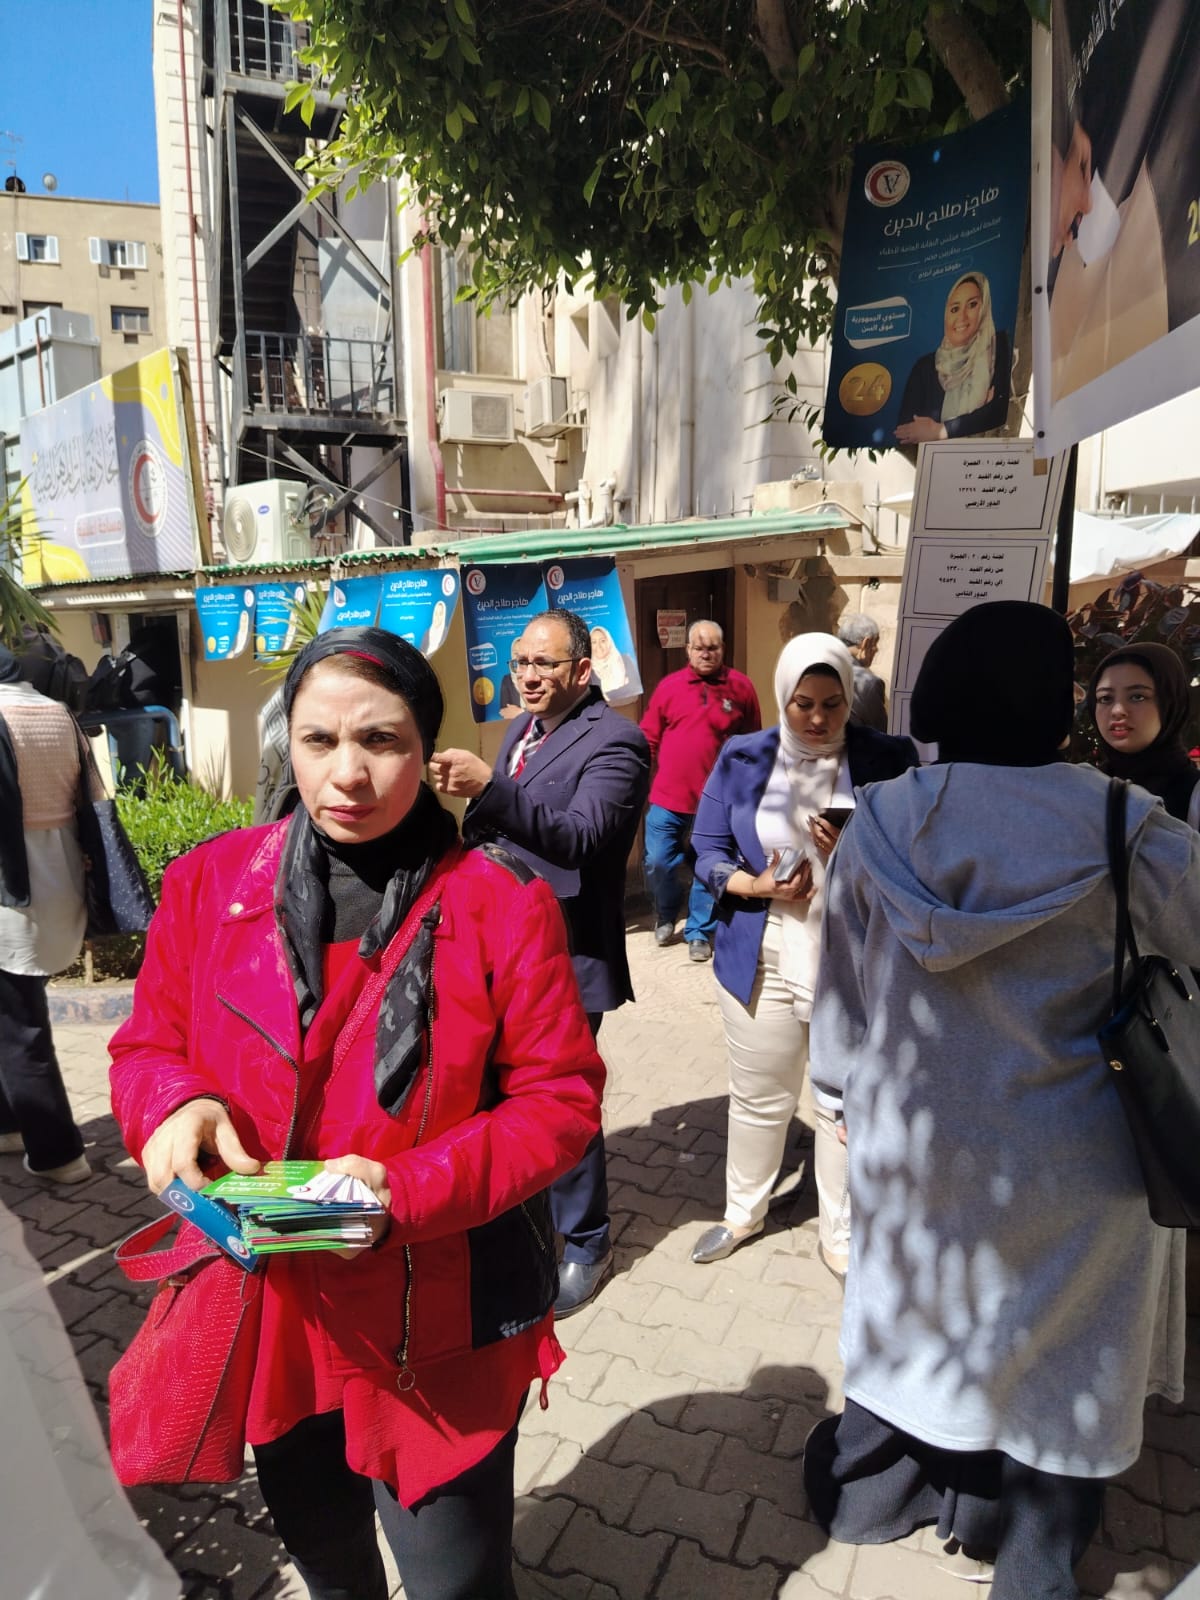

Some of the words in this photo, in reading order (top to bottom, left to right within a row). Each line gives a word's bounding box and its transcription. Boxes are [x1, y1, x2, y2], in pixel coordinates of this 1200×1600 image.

[963, 186, 1000, 217] هاجر
[925, 202, 961, 231] صلاح
[883, 211, 925, 236] الدين
[851, 314, 881, 325] الجمهورية
[861, 324, 878, 333] السن
[878, 323, 894, 332] فوق
[849, 374, 885, 401] 24
[995, 459, 1005, 467] رقم
[557, 593, 573, 605] الدين
[573, 591, 588, 603] صلاح
[588, 589, 604, 601] هاجر
[477, 599, 494, 611] الدين
[494, 598, 511, 610] صلاح
[511, 598, 529, 609] هاجر
